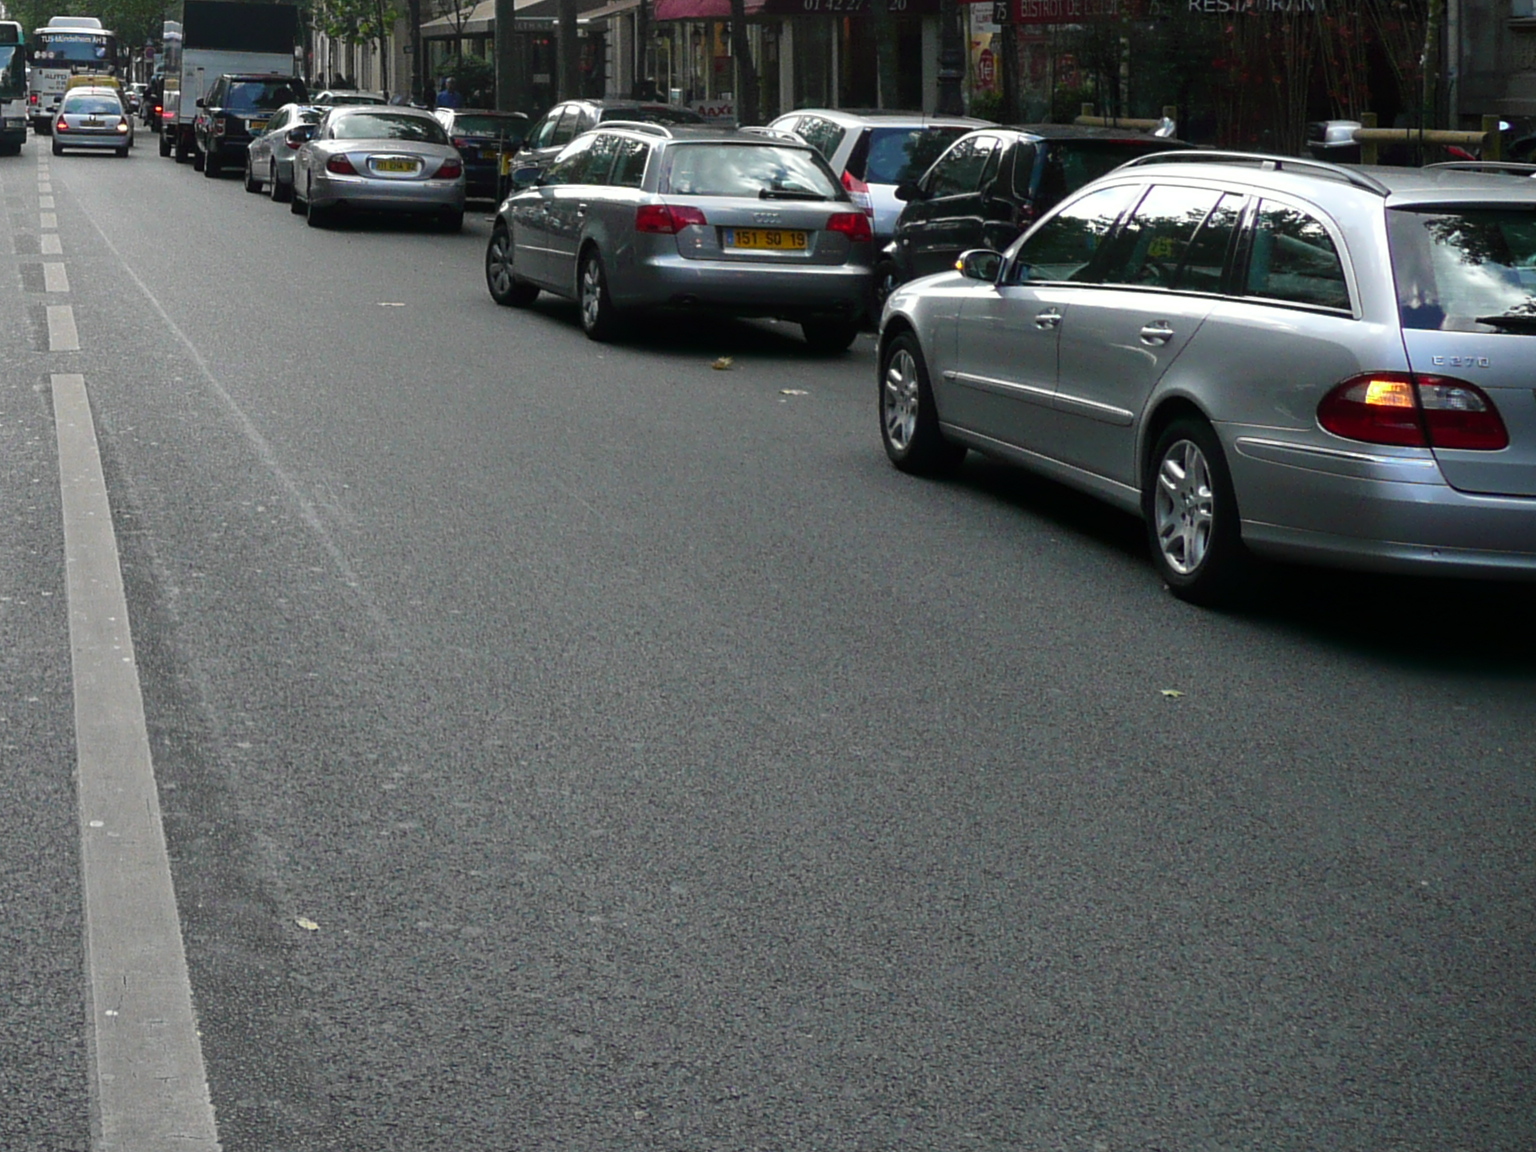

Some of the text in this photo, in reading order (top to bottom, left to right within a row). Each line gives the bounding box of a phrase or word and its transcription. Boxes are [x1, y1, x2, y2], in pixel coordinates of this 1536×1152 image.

[995, 1, 1007, 20] 75
[736, 231, 758, 245] 151
[790, 232, 806, 247] 19
[1432, 355, 1490, 369] E 270
